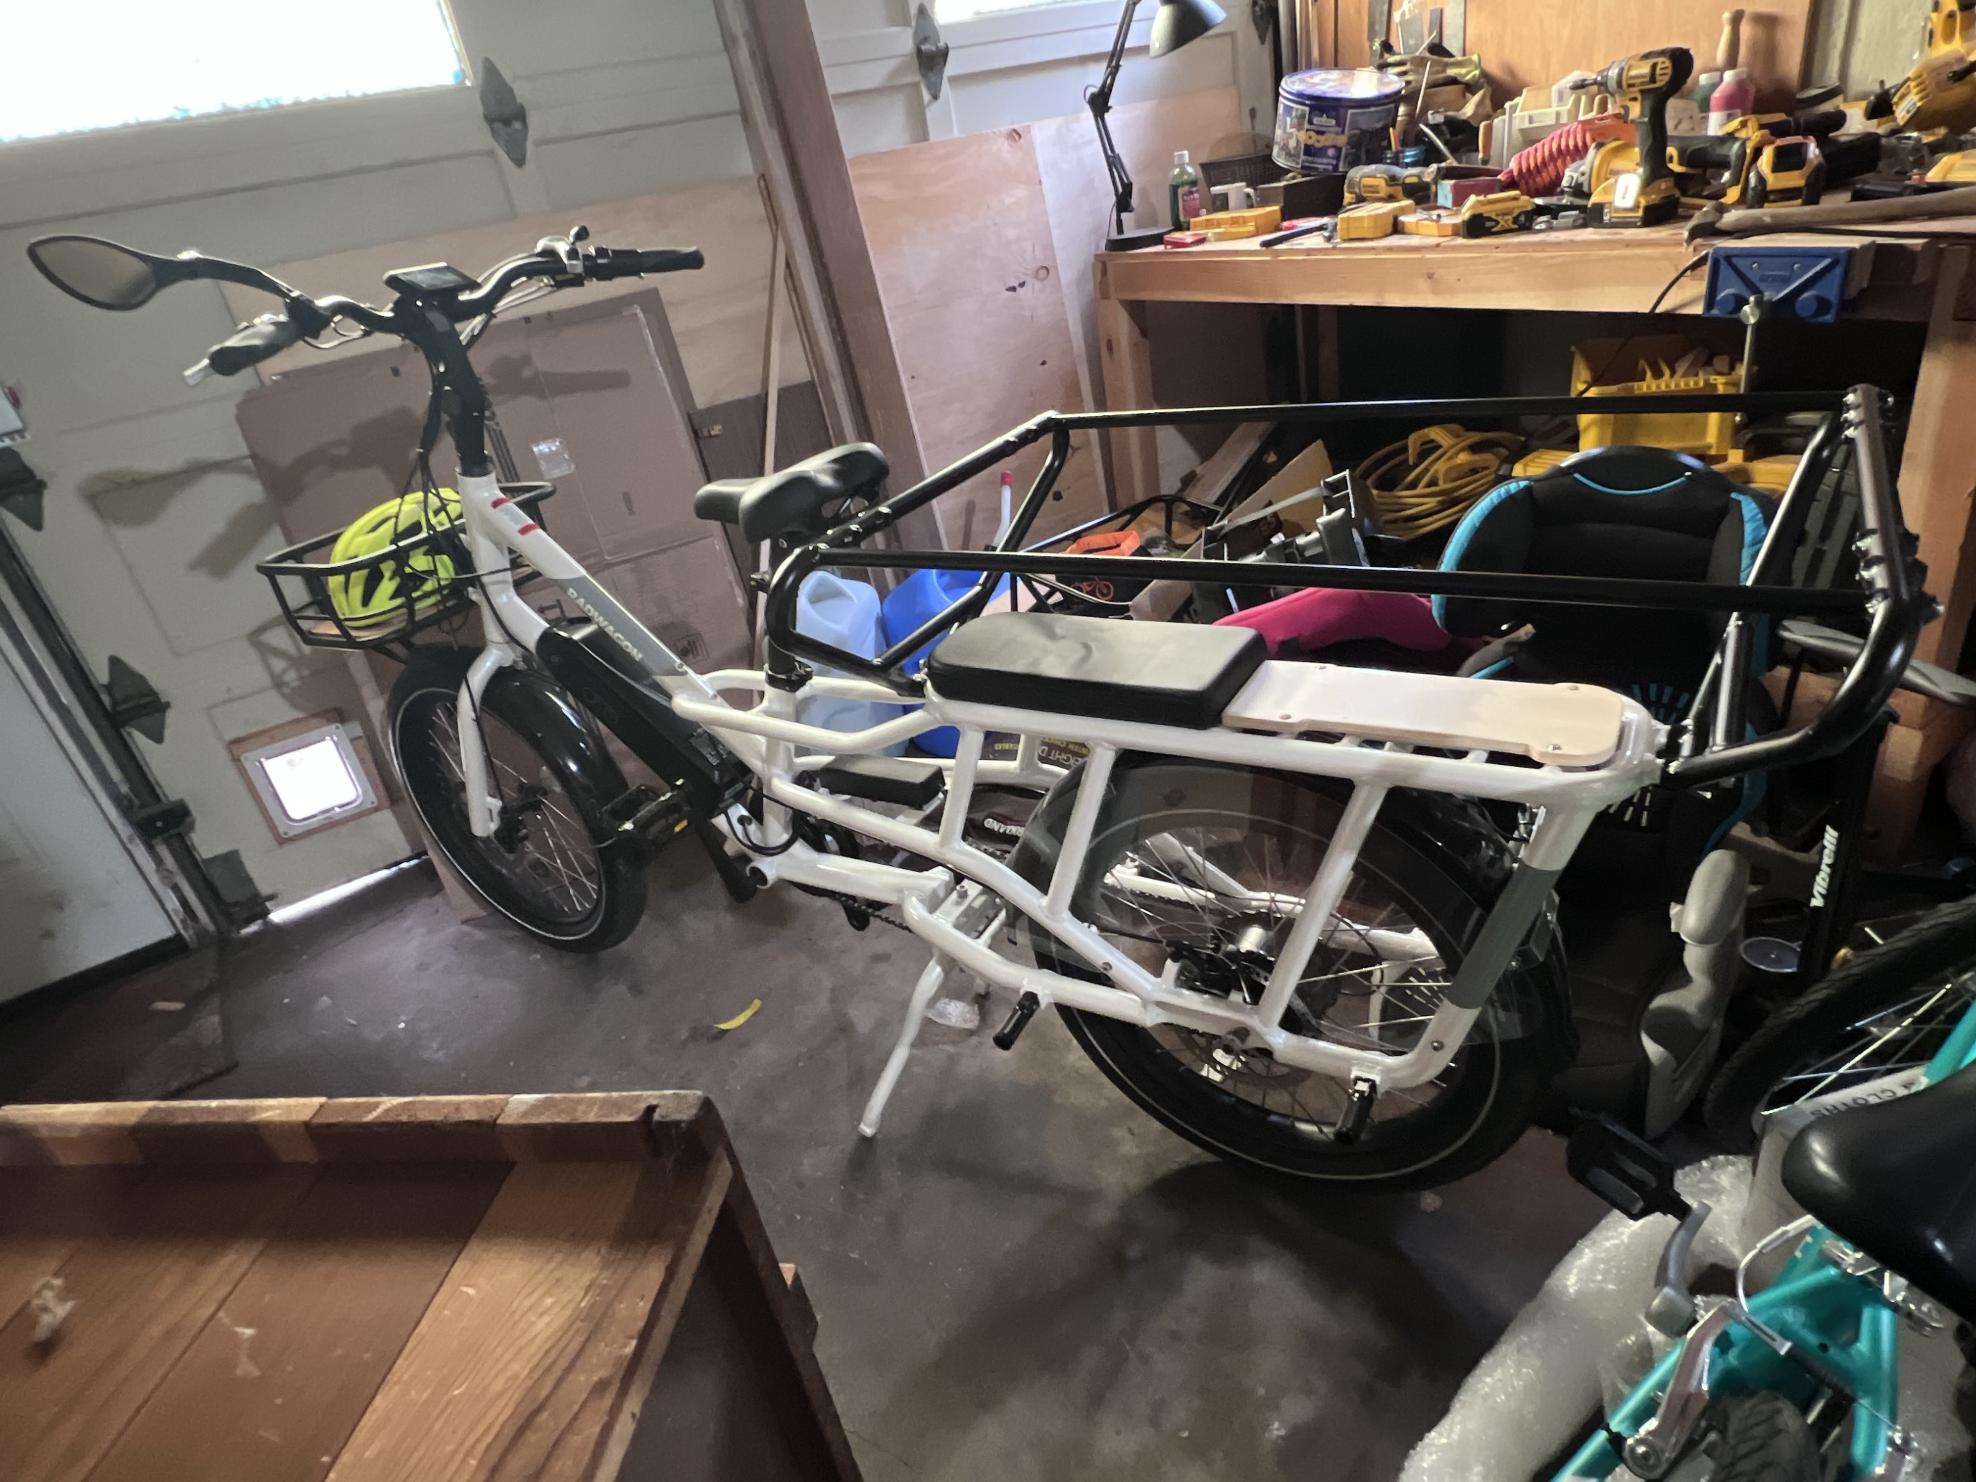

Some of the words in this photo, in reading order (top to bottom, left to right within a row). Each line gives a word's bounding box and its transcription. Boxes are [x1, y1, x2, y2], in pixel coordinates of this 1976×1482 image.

[567, 587, 644, 662] RADWAGON
[1809, 824, 1839, 907] Vibrelli
[1810, 1088, 1897, 1118] CLOTHS
